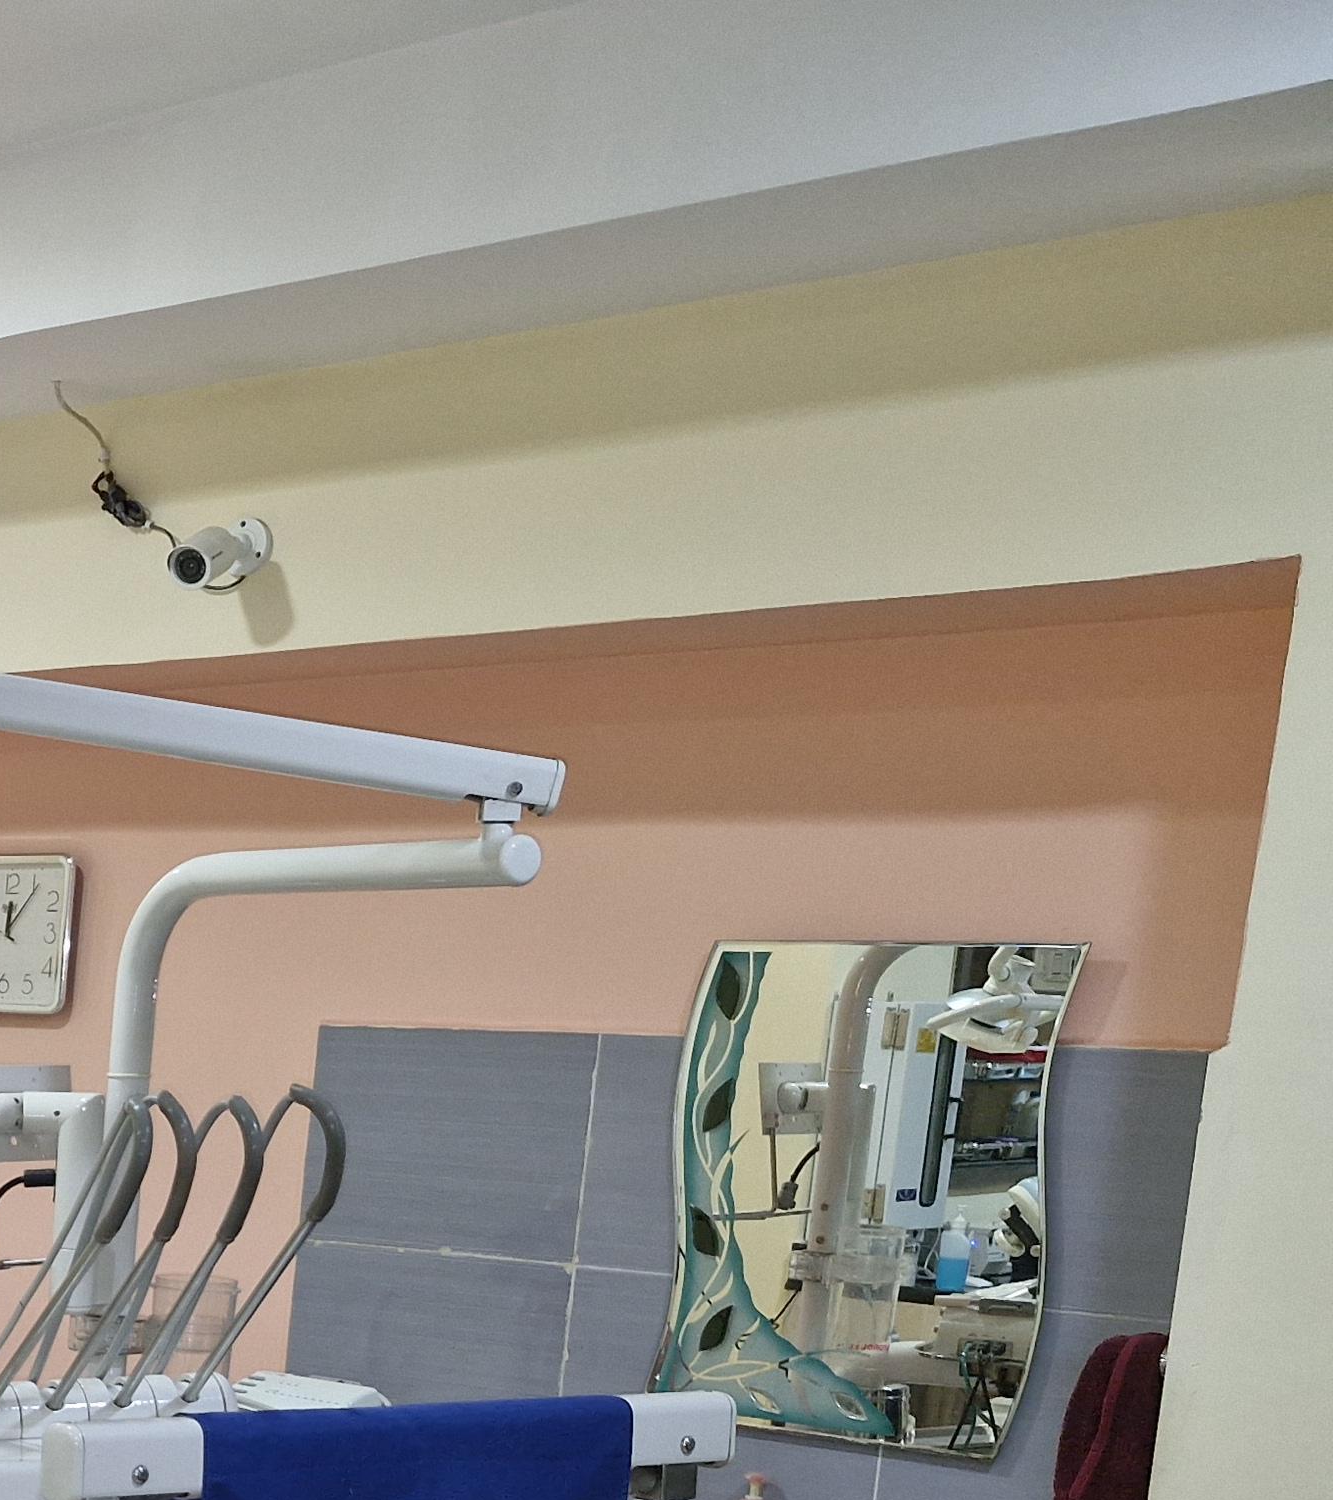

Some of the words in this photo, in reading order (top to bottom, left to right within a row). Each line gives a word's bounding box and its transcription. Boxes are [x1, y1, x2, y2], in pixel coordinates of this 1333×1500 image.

[5, 873, 21, 895] 12
[46, 890, 60, 912] 2
[43, 922, 57, 944] 3
[41, 956, 53, 978] 4
[21, 973, 34, 995] 5
